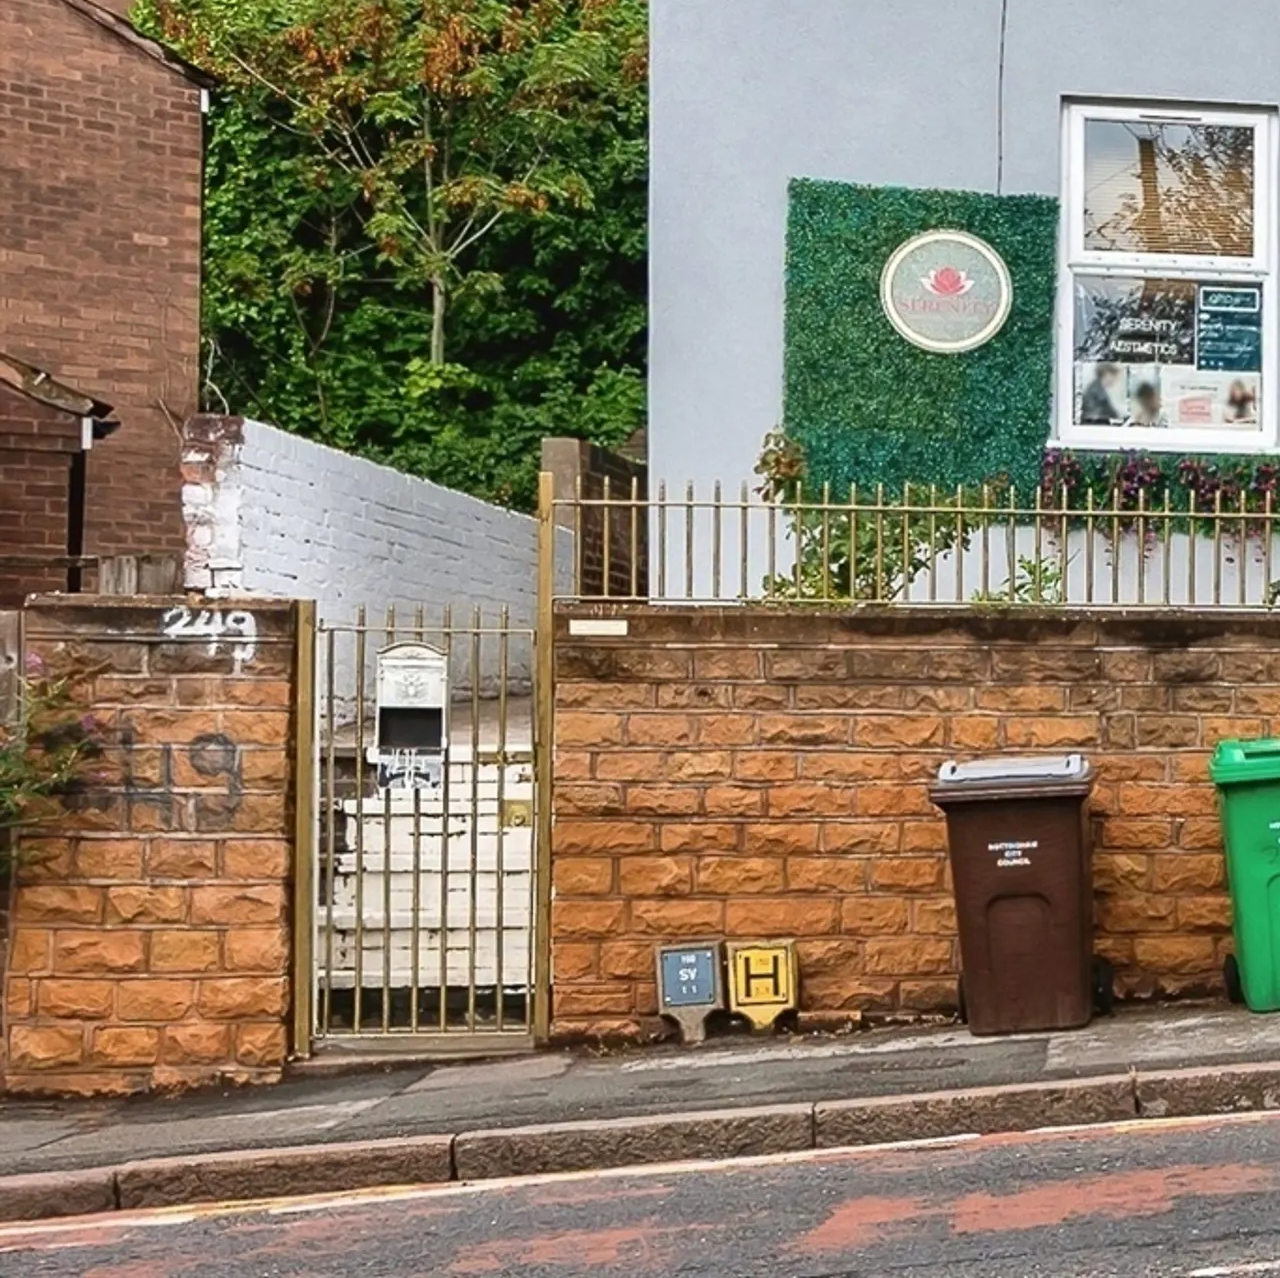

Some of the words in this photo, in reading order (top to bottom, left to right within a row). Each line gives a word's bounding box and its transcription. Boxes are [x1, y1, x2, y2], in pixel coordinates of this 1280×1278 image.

[899, 298, 995, 315] SERENITY
[1119, 317, 1177, 332] SERENITY
[1110, 339, 1178, 356] AESTHETICS
[162, 606, 258, 662] 249
[997, 858, 1031, 867] COUNCIL
[1004, 850, 1022, 858] CITY
[744, 955, 779, 998] H
